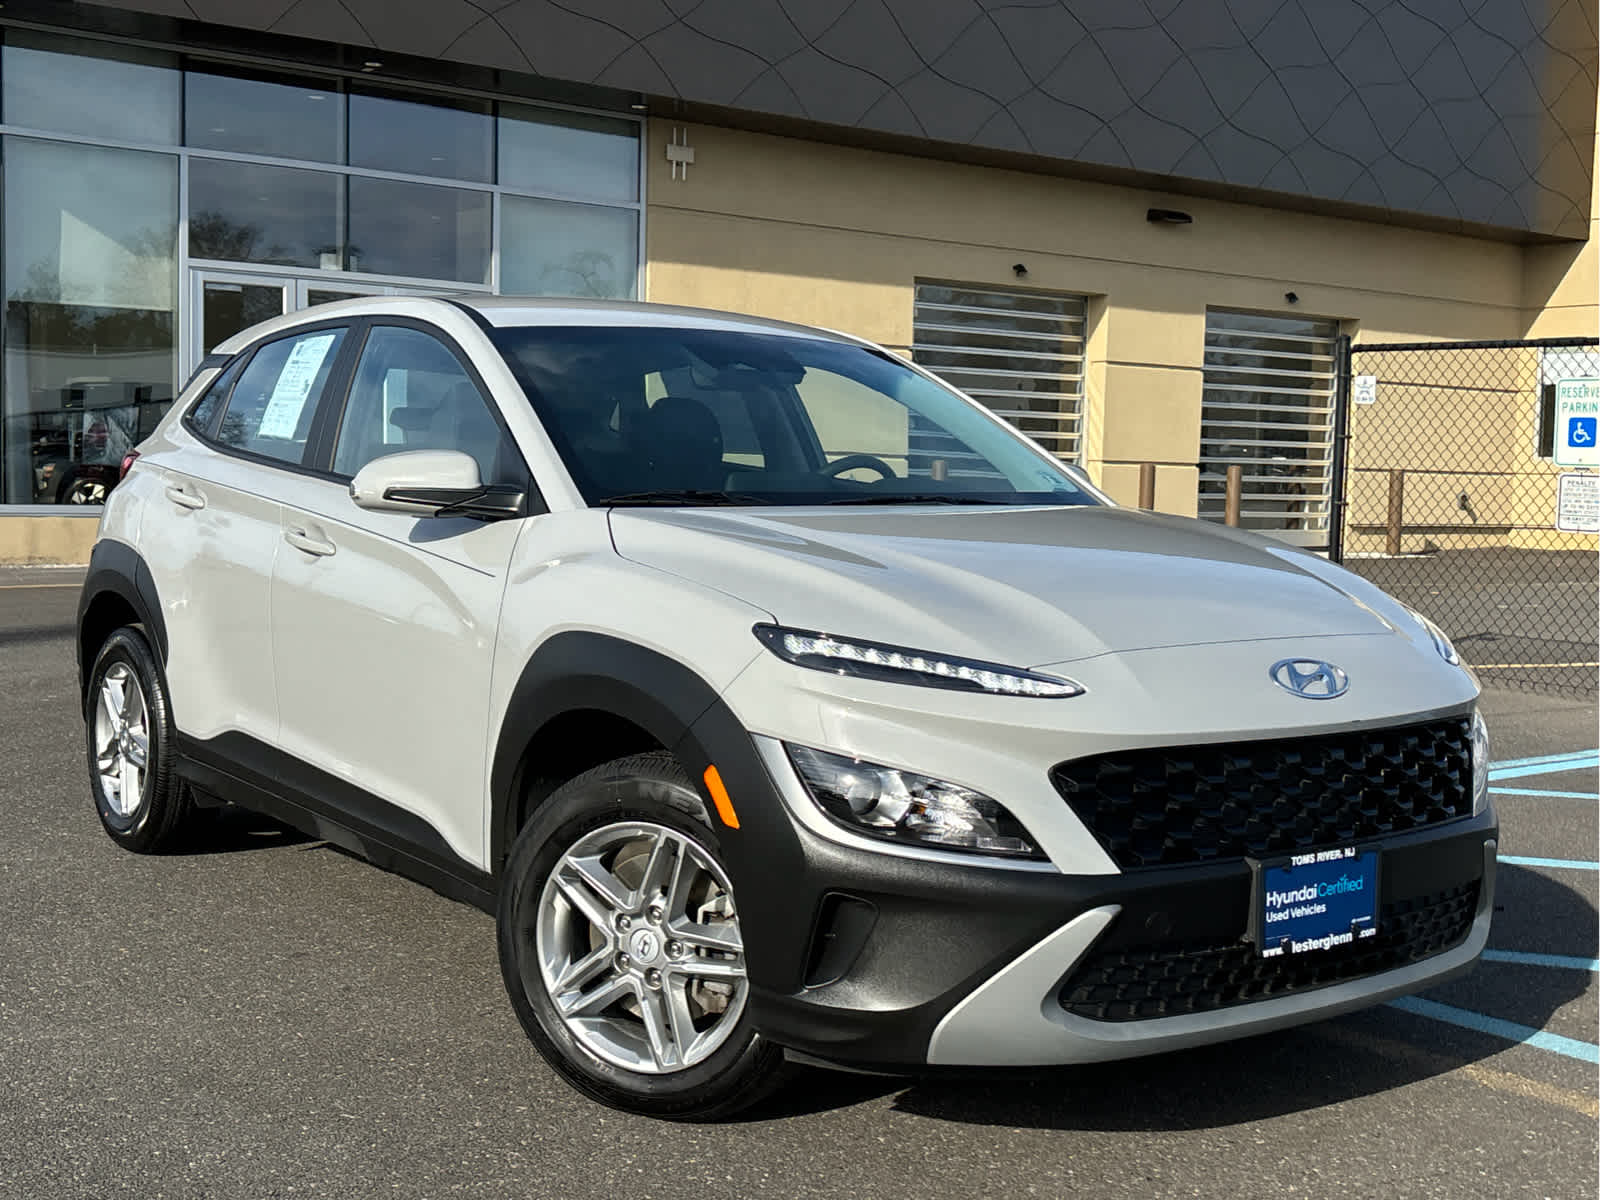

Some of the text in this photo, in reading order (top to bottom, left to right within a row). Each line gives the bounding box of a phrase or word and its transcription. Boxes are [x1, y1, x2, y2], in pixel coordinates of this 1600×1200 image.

[1291, 855, 1315, 866] TOMS
[1344, 848, 1356, 858] NJ
[1266, 903, 1327, 923] Used Vehicles
[1291, 932, 1353, 954] lesterglenn
